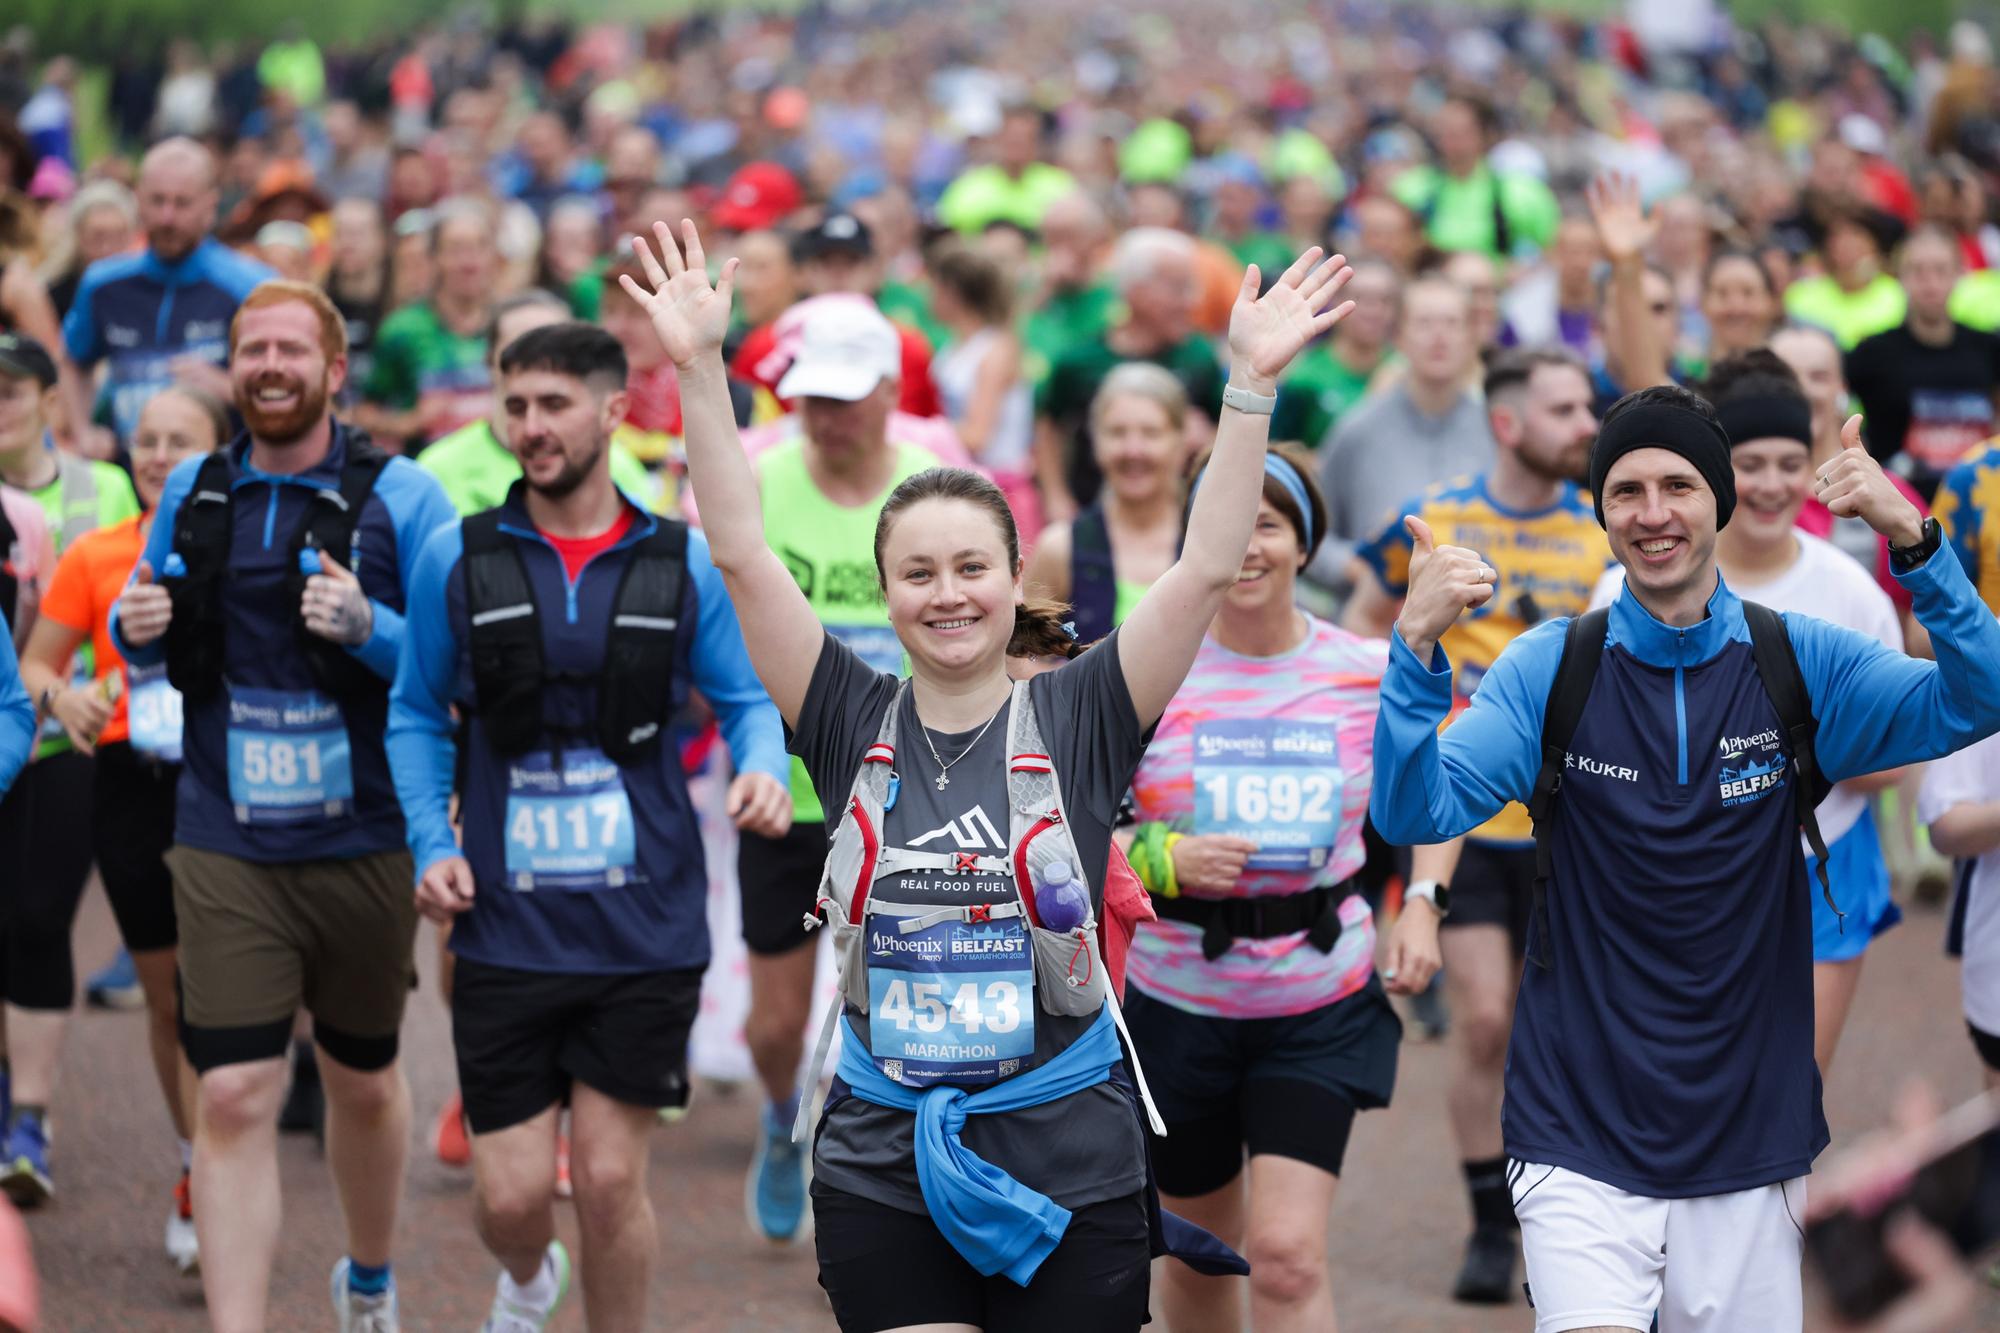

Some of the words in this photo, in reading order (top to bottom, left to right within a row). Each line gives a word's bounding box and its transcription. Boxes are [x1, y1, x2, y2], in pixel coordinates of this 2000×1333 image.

[1730, 728, 1779, 751] Phoenix
[243, 740, 321, 785] 581
[1578, 755, 1639, 782] KUKRI
[1720, 767, 1785, 799] BELFAST
[1204, 773, 1333, 823] 1692
[1722, 798, 1738, 808] CITY
[511, 802, 620, 849] 4117
[900, 879, 930, 891] REAL
[934, 881, 970, 892] FOOD
[976, 882, 1007, 892] FUEL
[881, 935, 943, 952] Phoenix
[952, 939, 1025, 954] BELFAST
[918, 953, 943, 962] Energy
[952, 953, 968, 961] CITY
[969, 952, 1008, 961] MARATHON
[879, 979, 1021, 1034] 4543
[904, 1042, 996, 1059] MARATHON
